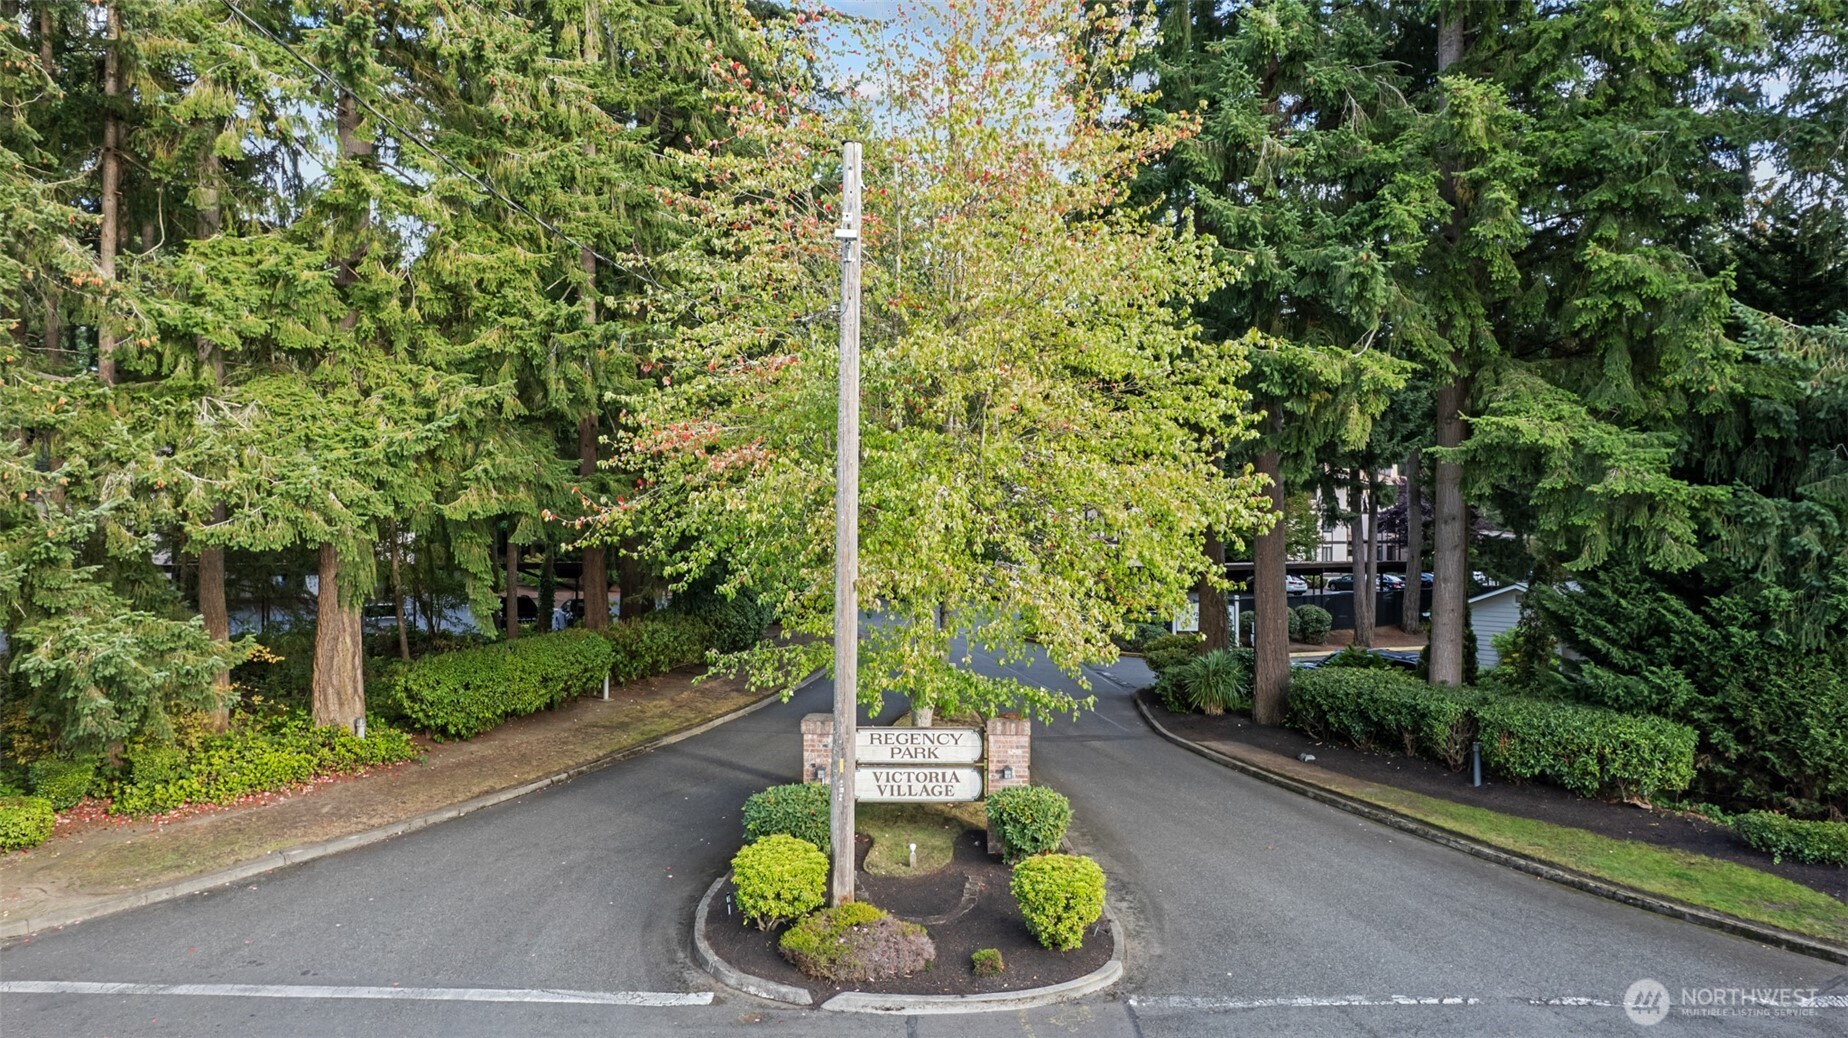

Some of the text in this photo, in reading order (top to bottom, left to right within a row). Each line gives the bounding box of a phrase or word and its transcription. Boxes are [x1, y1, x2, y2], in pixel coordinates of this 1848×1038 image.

[870, 733, 963, 745] REGENCY
[890, 747, 939, 759] PARK
[872, 771, 960, 783] VICTORIA
[876, 784, 955, 797] VILLAGE
